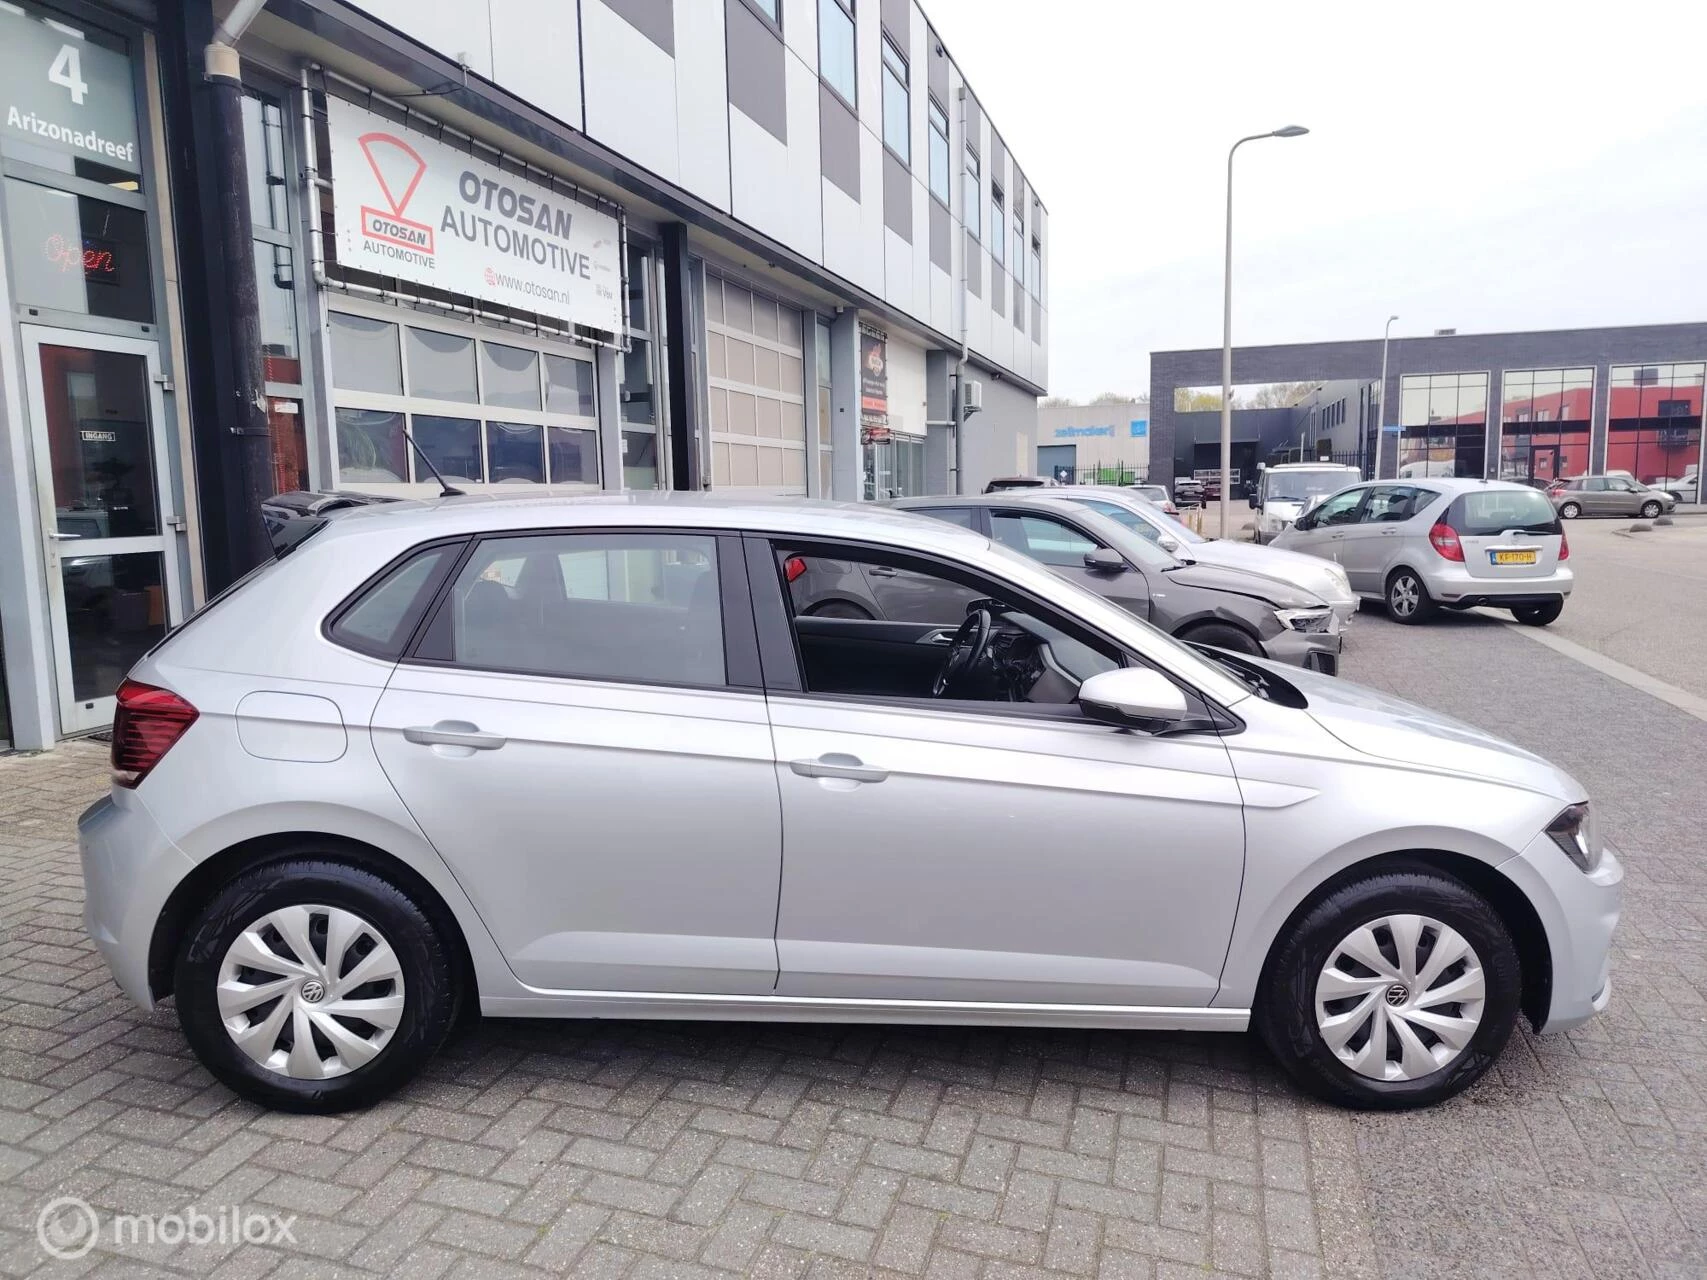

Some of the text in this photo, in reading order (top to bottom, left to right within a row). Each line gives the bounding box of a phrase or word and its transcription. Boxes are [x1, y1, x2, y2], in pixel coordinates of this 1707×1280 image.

[48, 43, 88, 105] 4
[7, 106, 133, 162] Arizonadreef
[459, 170, 573, 240] OTOSAN
[372, 219, 426, 246] OTOSAN
[440, 205, 591, 280] AUTOMOTIVE
[46, 233, 115, 272] Open
[363, 240, 436, 269] AUTOMOTIVE
[495, 272, 570, 305] www.otosan.nl
[84, 431, 113, 440] INGANG
